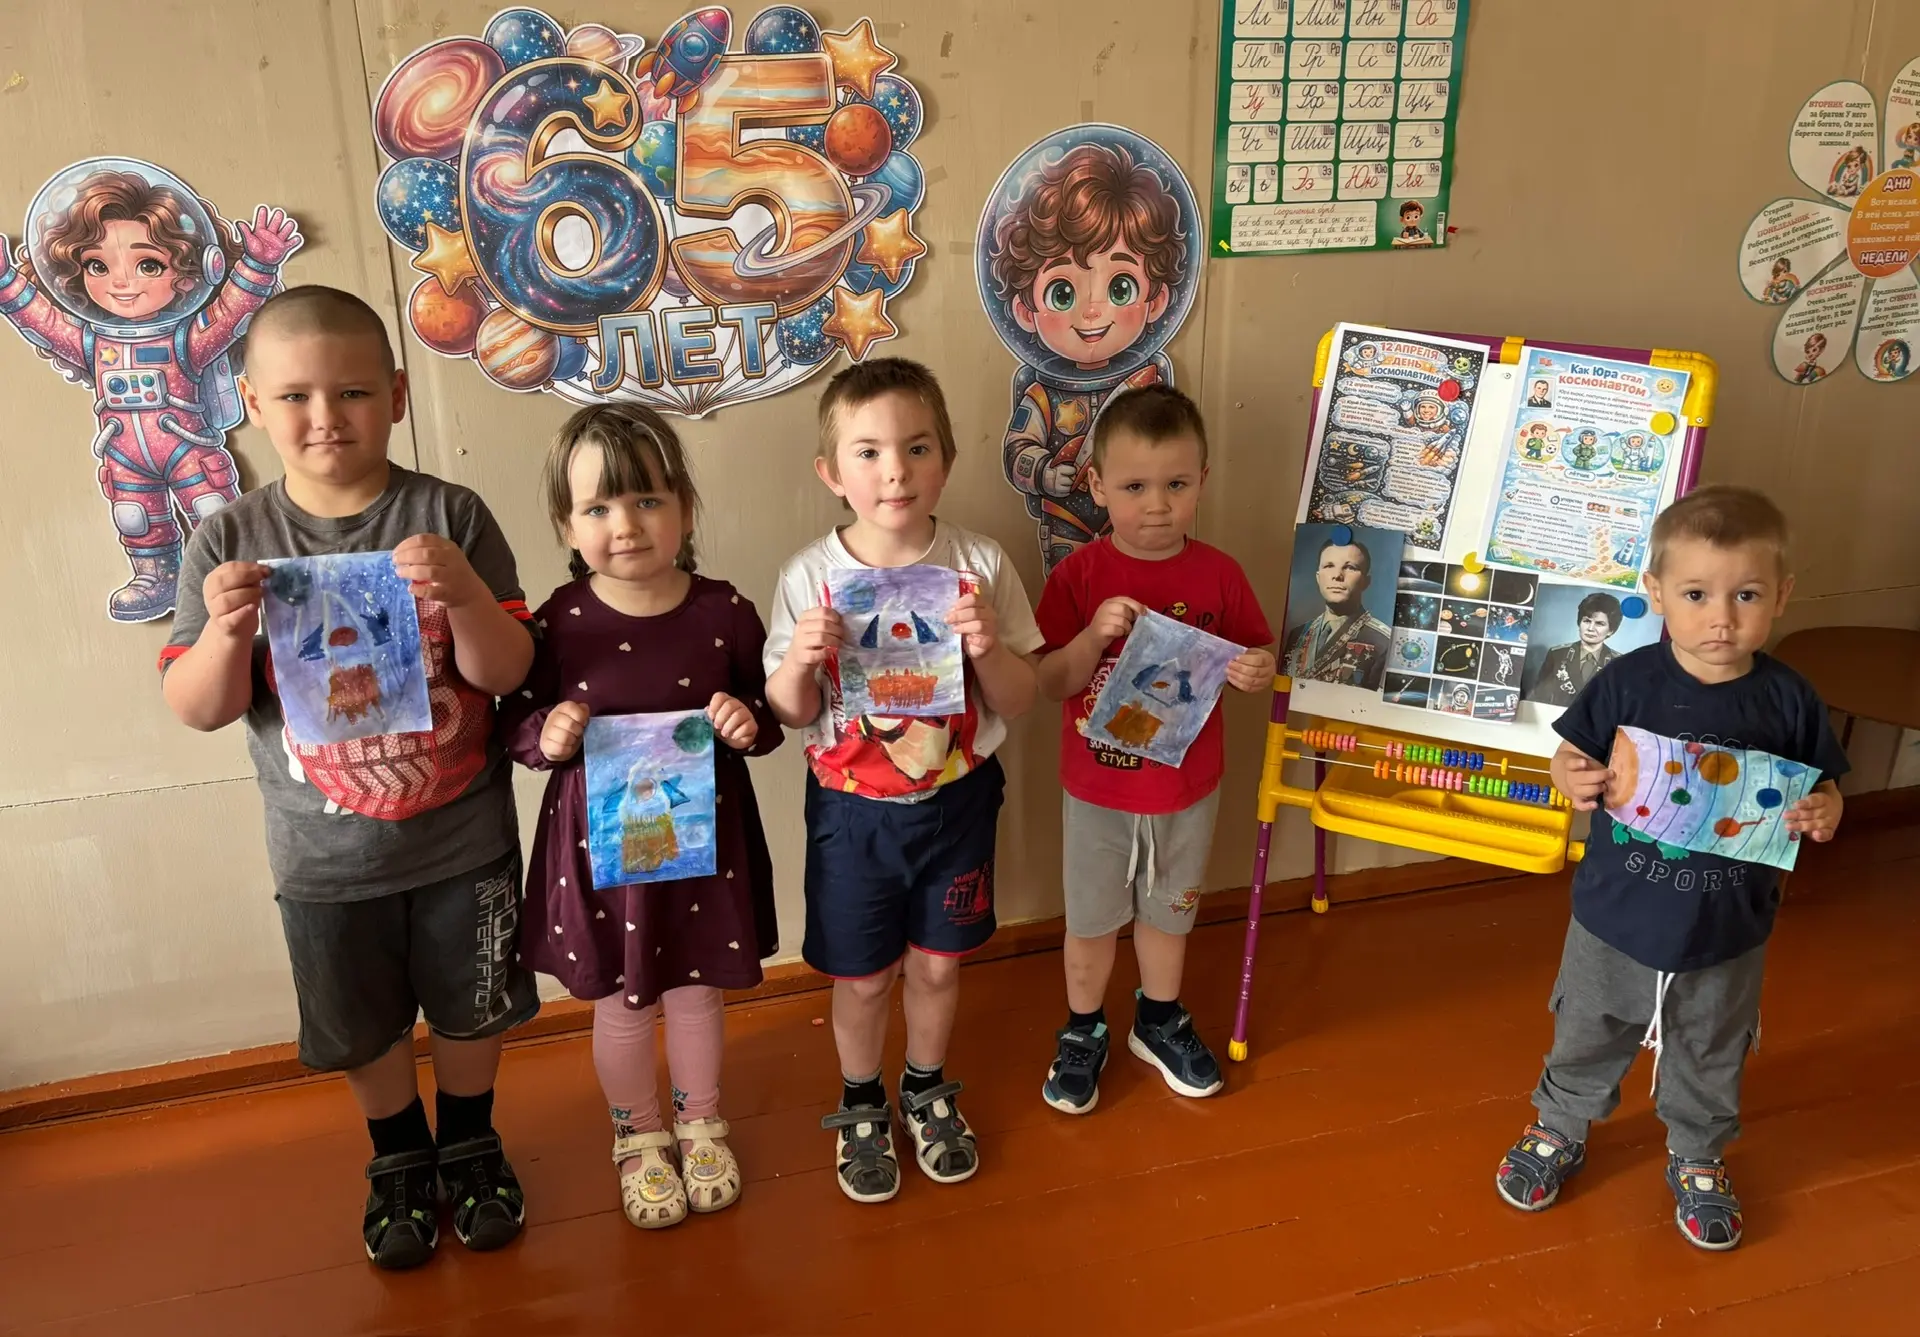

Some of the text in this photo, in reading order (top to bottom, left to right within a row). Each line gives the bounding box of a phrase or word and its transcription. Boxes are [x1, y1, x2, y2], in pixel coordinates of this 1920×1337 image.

[1237, 43, 1271, 68] Пп
[1273, 43, 1284, 54] Пп
[1331, 43, 1340, 56] Рр
[1358, 43, 1379, 67] Сс
[1386, 42, 1396, 54] Сс
[1442, 42, 1449, 53] Тт
[1300, 43, 1325, 77] Рр
[1271, 84, 1281, 97] Уу
[1324, 84, 1338, 96] Фф
[1349, 84, 1384, 108] Хх
[1382, 83, 1392, 94] Хх
[1405, 83, 1435, 114] Цц
[1242, 84, 1265, 119] Уу
[1296, 84, 1325, 119] Фф
[1239, 126, 1263, 151] Чч
[1268, 125, 1278, 136] Чч
[1291, 126, 1331, 150] Шш
[1344, 125, 1387, 155] Щщ
[1882, 176, 1912, 192] ДНИ
[460, 53, 857, 337] 65
[1860, 250, 1909, 266] НЕДЕЛИ
[591, 302, 778, 392] ЛЕТ
[1380, 342, 1439, 359] 12 АПРЕЛЯ
[1392, 356, 1422, 369] ДЕНЬ
[1370, 367, 1444, 383] КОСМОНАВТИКИ
[1570, 363, 1643, 384] Как Юра стал
[1558, 375, 1646, 397] космонавтом
[1100, 752, 1139, 767] STYLE
[1625, 852, 1748, 892] SPORT
